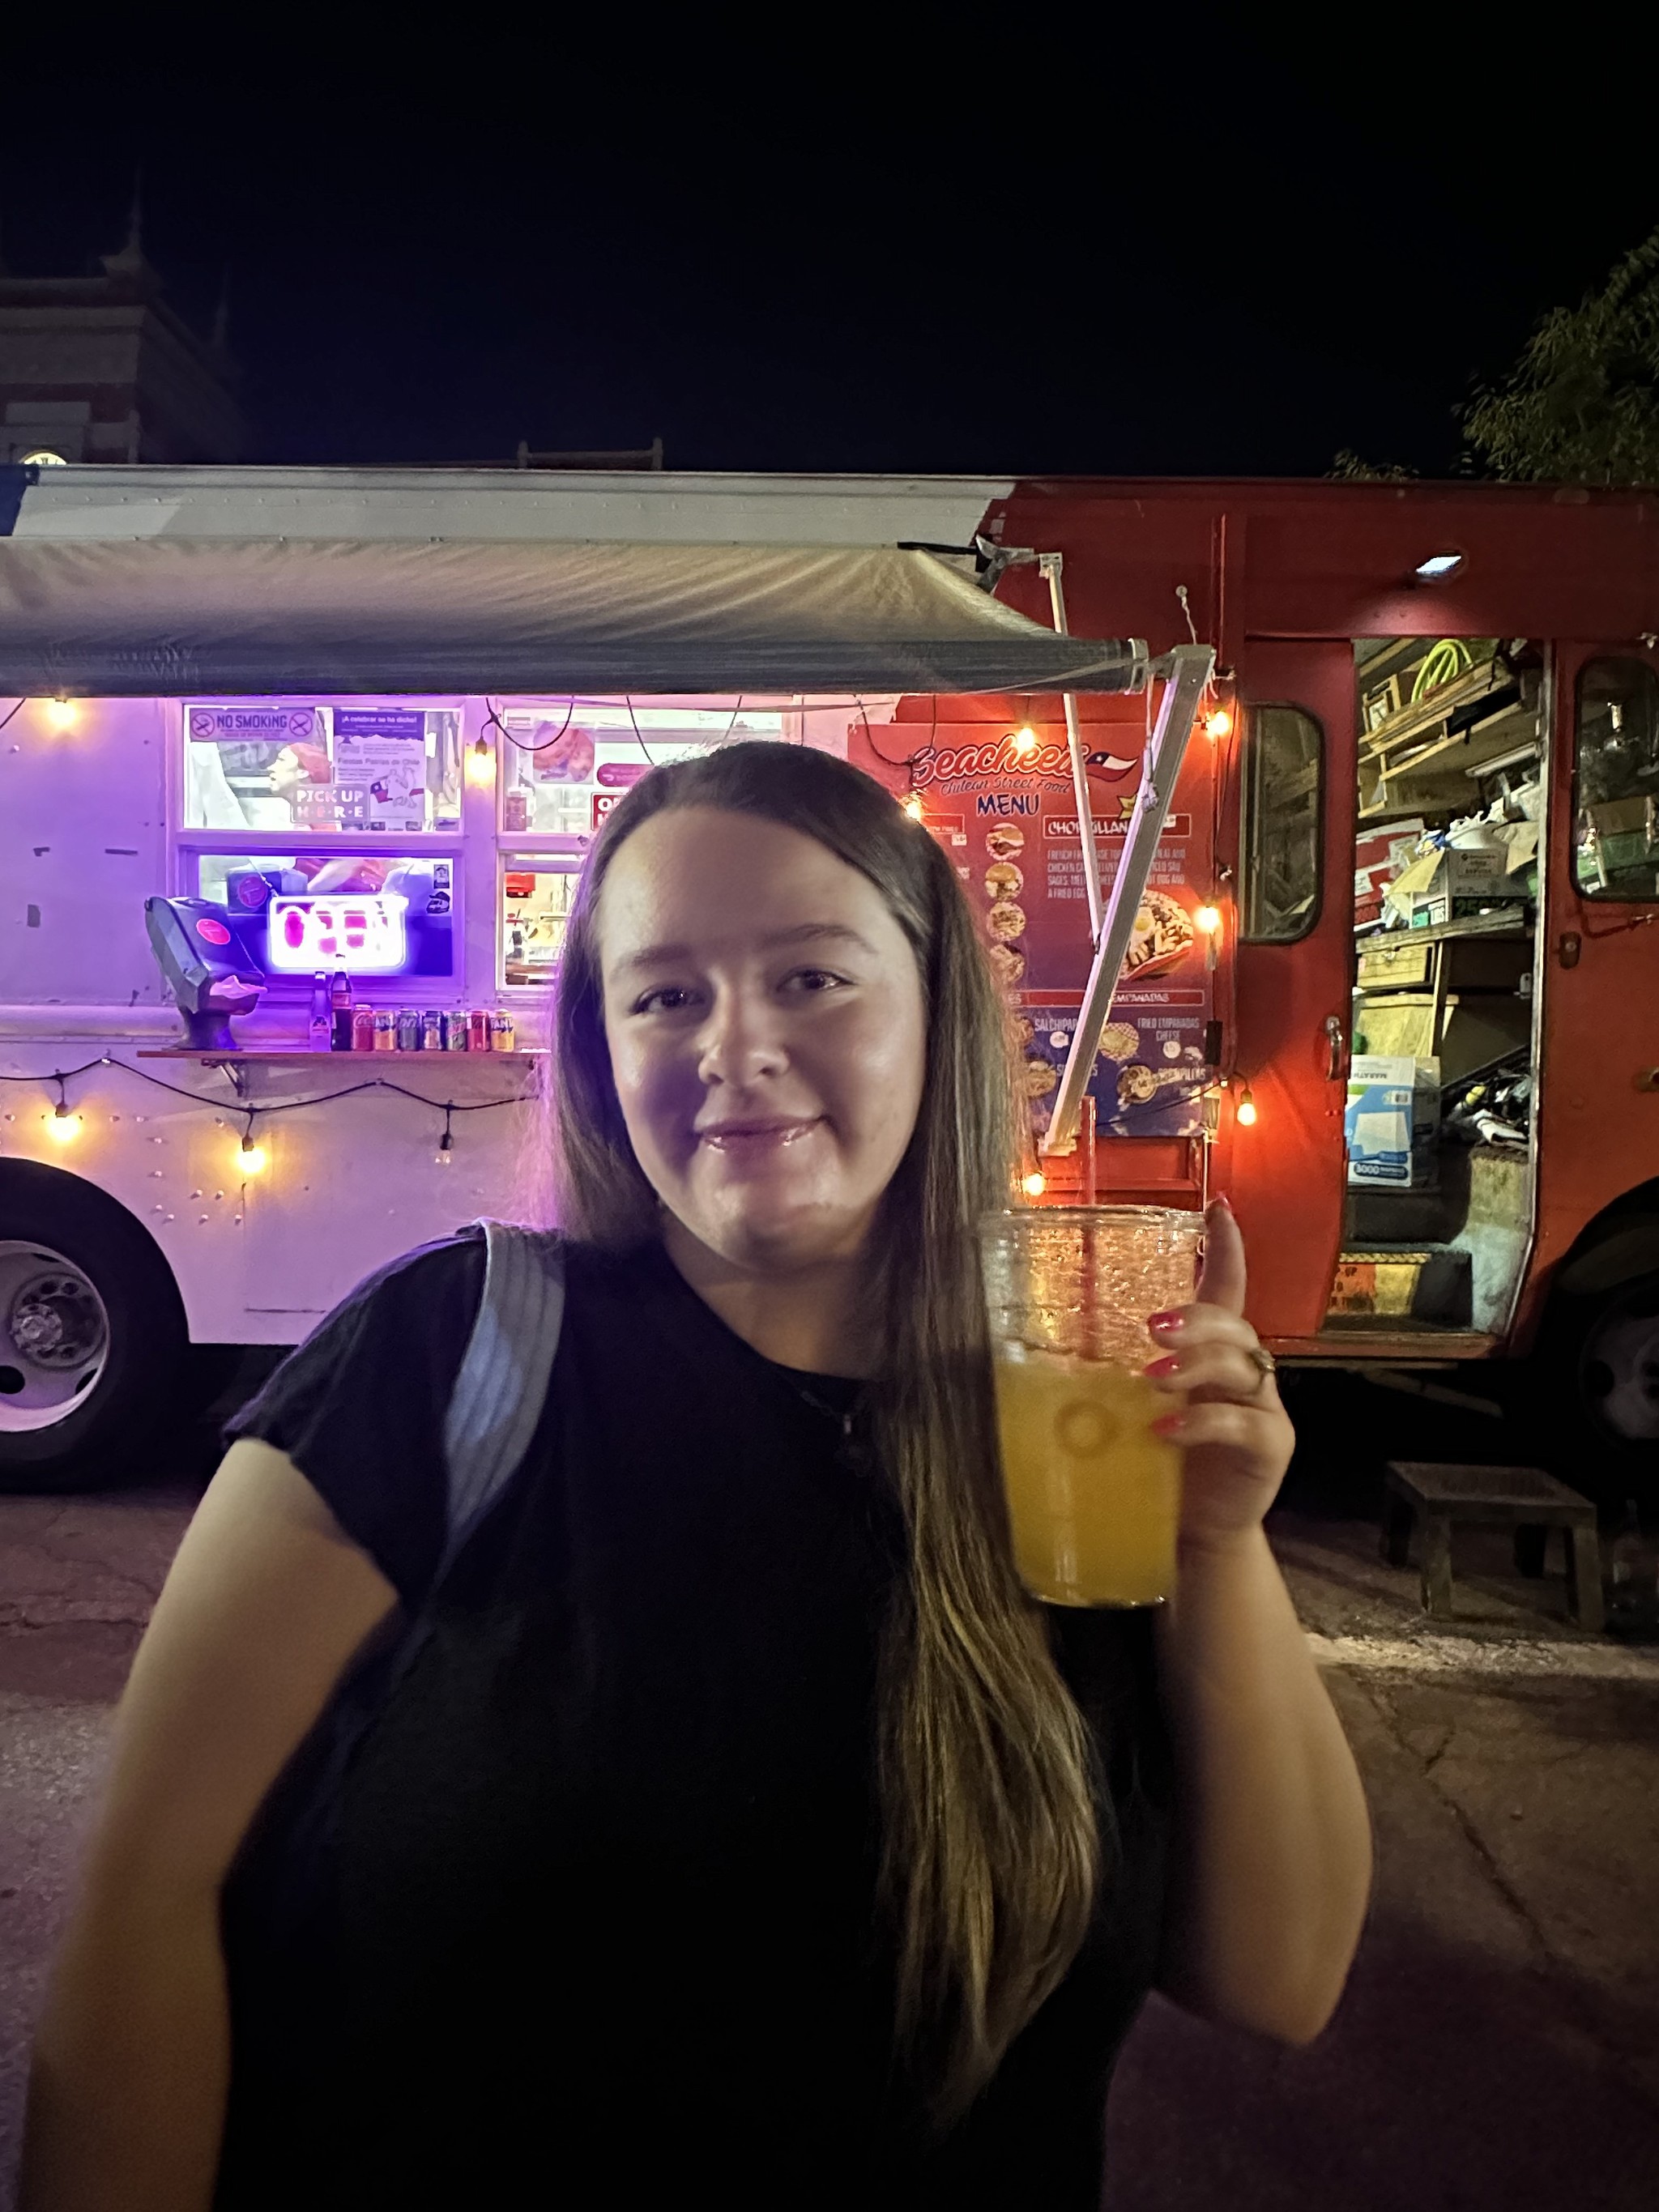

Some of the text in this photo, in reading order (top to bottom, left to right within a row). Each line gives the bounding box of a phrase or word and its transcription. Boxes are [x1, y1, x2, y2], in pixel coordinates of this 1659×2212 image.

[216, 714, 288, 728] NO SMOKING
[940, 776, 1071, 795] Chilean Street Food
[296, 790, 364, 803] PICK UP
[977, 794, 1040, 816] MENU
[1137, 1017, 1157, 1029] FRIED
